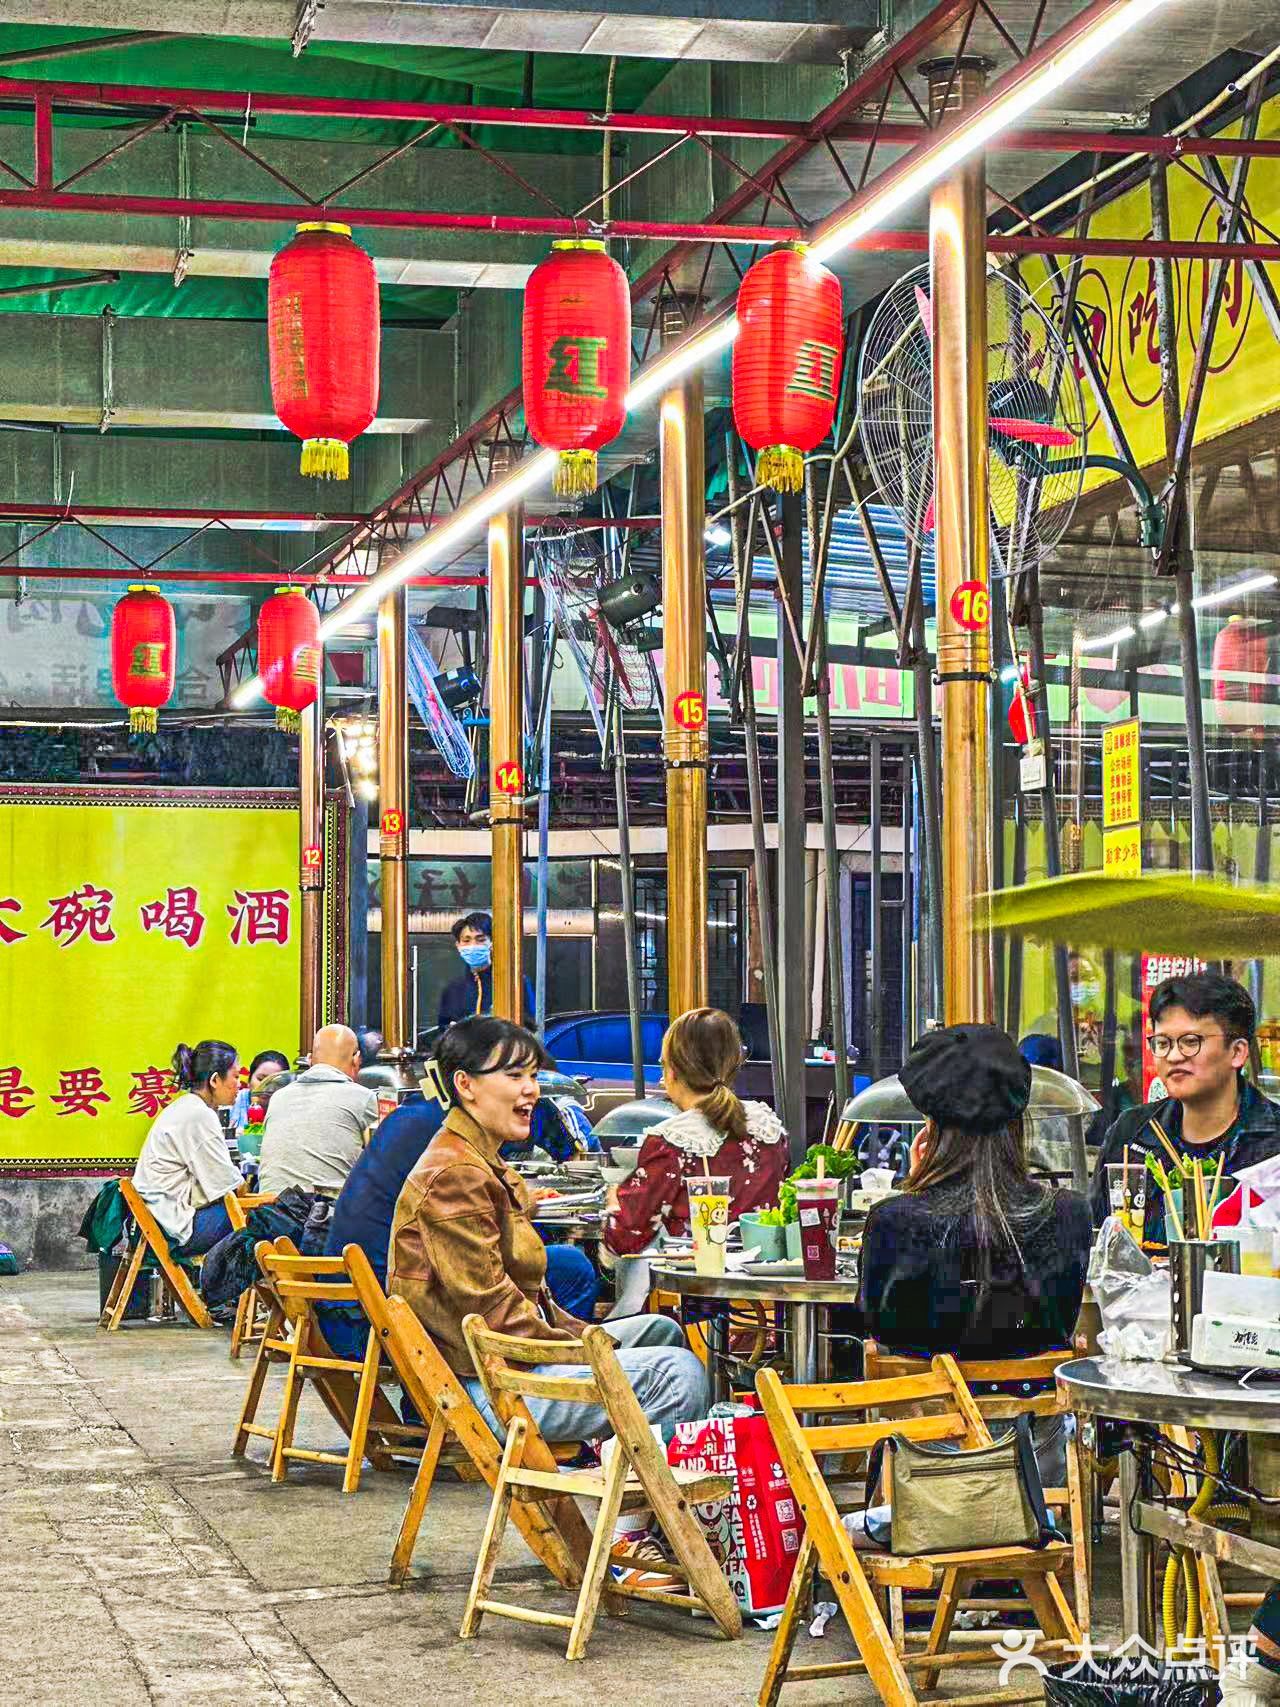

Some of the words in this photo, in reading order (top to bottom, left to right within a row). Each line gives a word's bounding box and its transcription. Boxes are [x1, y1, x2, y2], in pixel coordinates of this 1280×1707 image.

[958, 589, 989, 623] 16
[677, 697, 704, 723] 15
[498, 767, 521, 788] 14
[382, 814, 400, 831] 13
[304, 850, 321, 865] 12
[679, 1456, 707, 1472] AND
[710, 1453, 737, 1471] TEA
